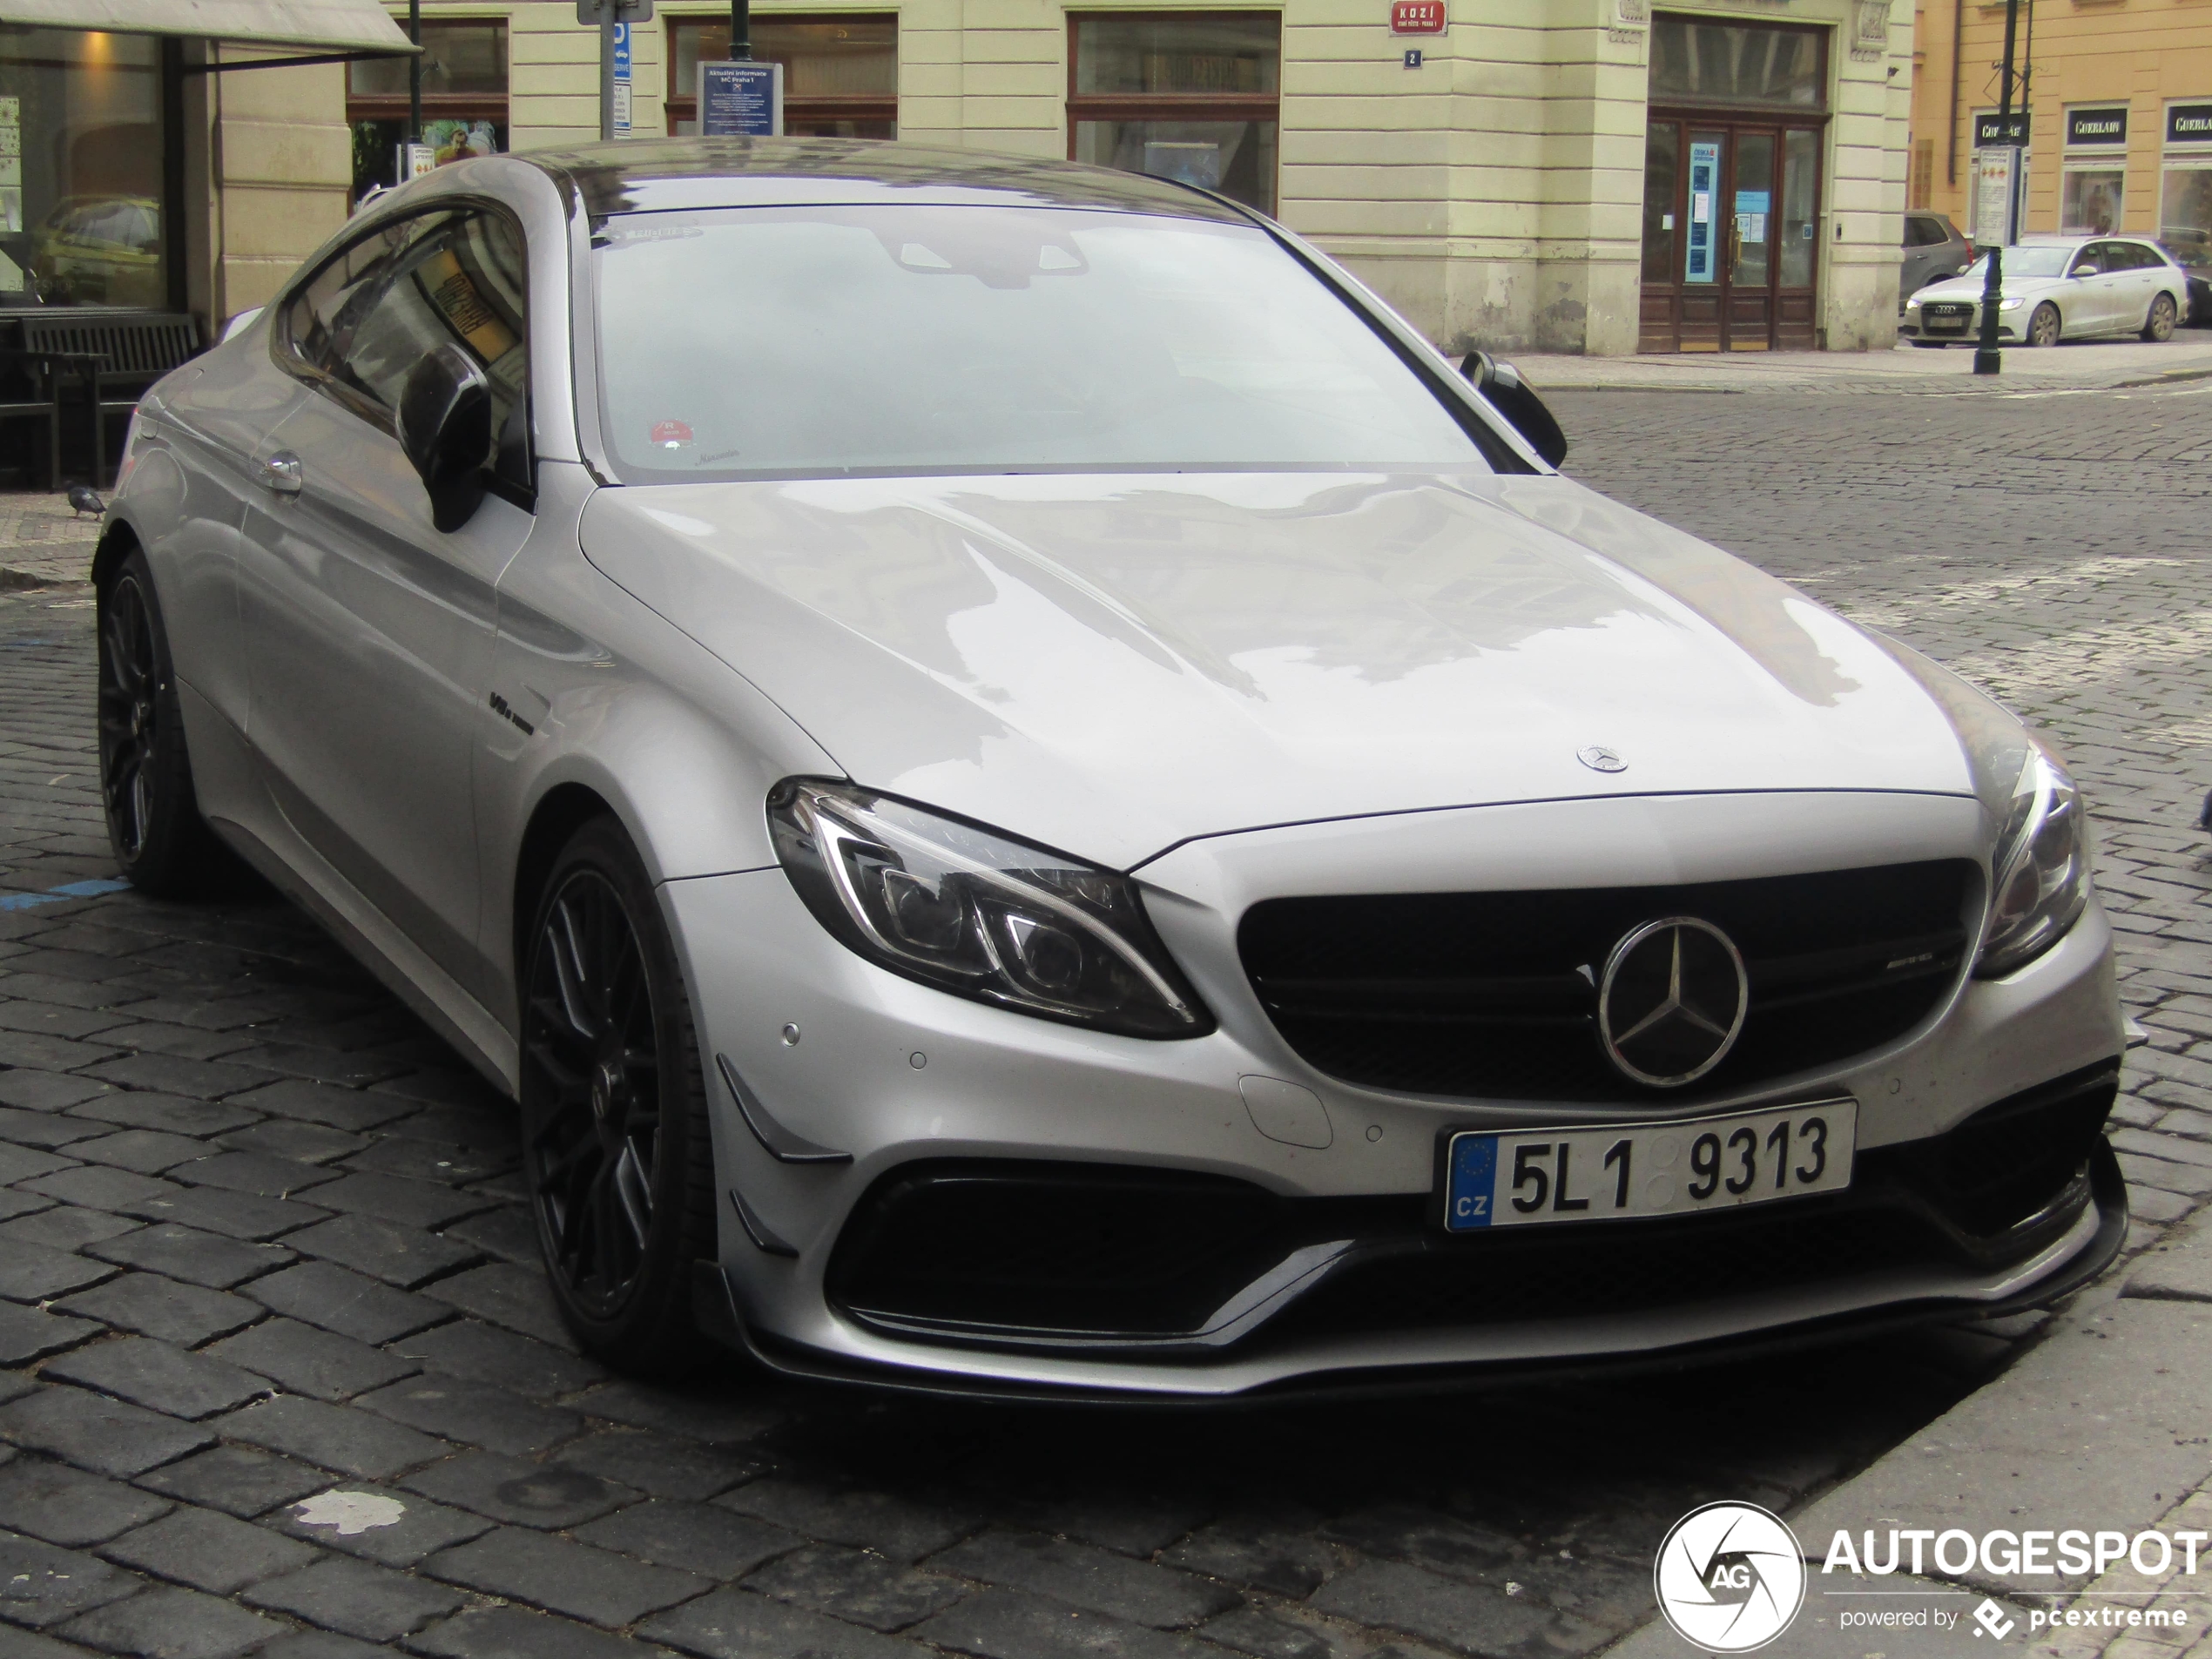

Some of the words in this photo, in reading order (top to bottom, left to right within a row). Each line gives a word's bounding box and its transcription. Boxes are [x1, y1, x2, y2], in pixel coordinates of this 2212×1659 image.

[1399, 5, 1434, 19] KOZÍ
[1410, 53, 1415, 64] 2
[2075, 121, 2121, 134] GUERLAIN
[1511, 1139, 1634, 1213] 5L1
[1688, 1116, 1828, 1201] 9313
[1456, 1195, 1487, 1217] CZ
